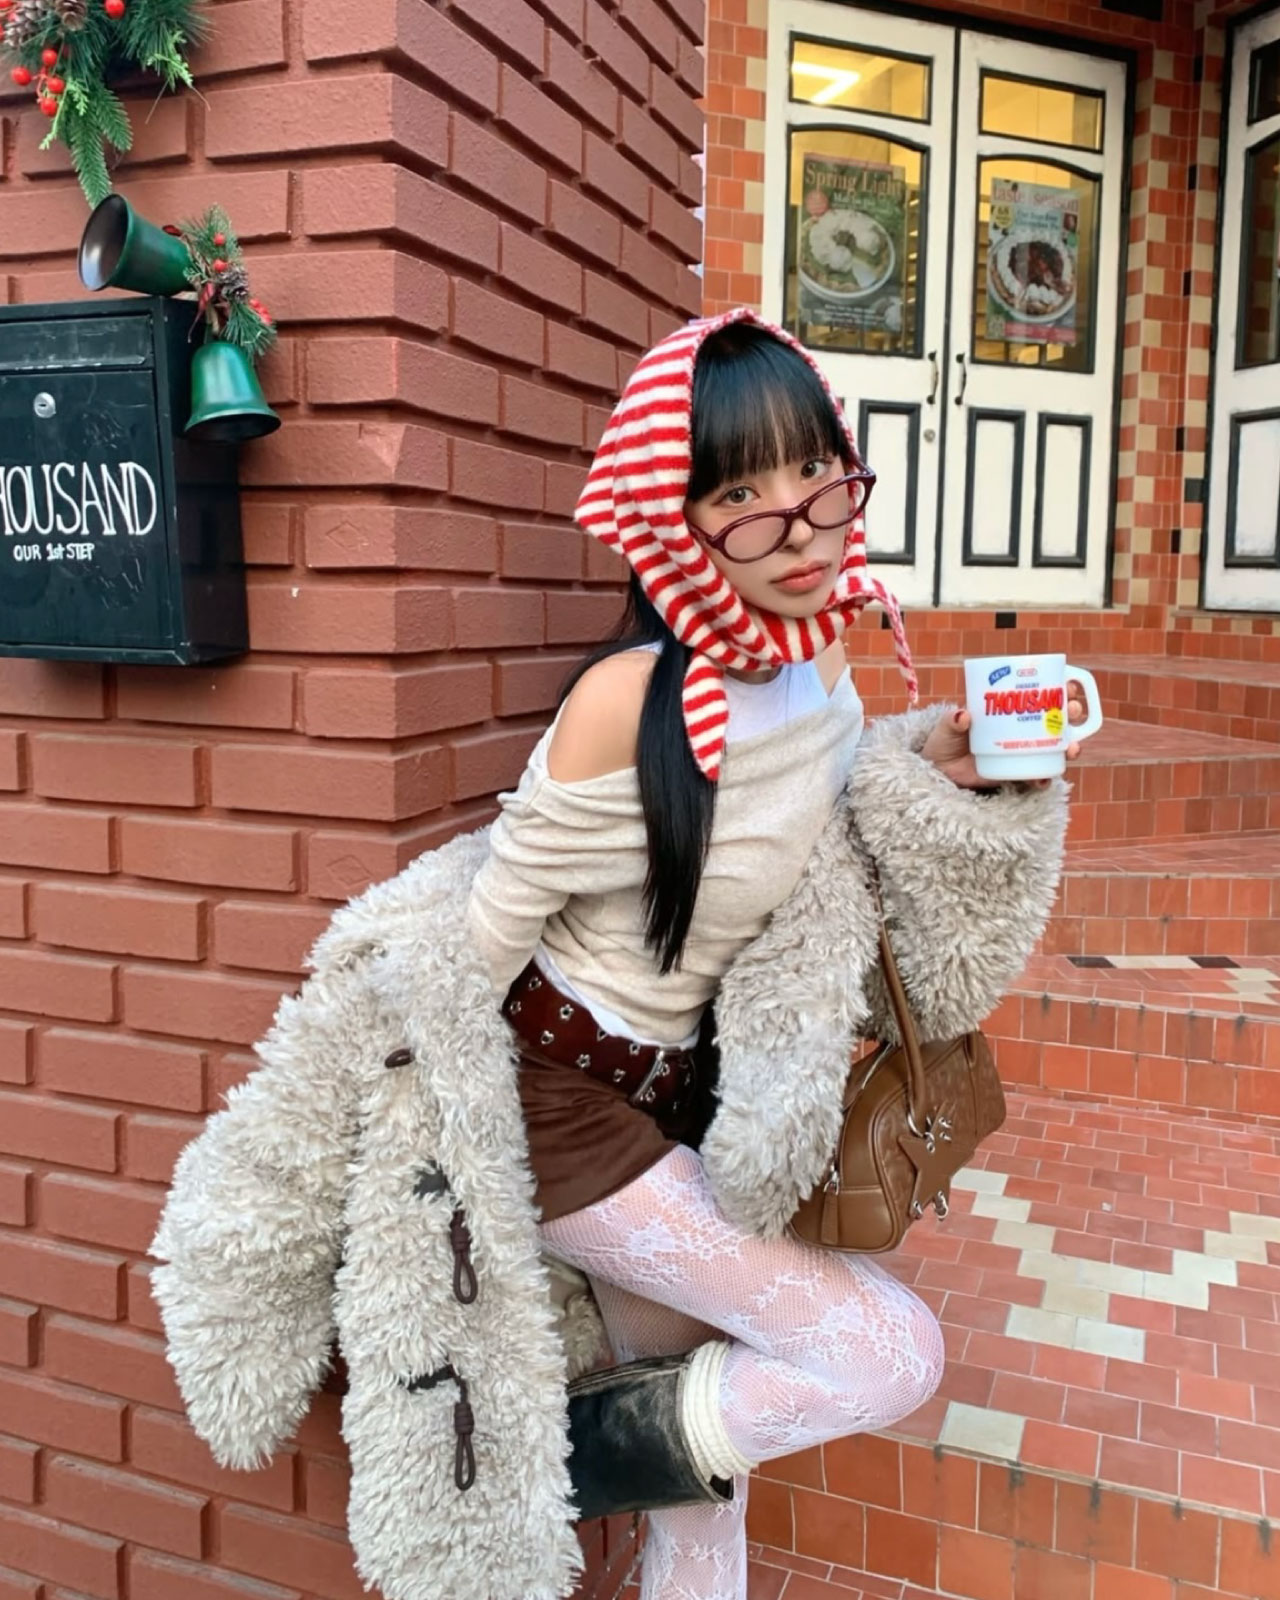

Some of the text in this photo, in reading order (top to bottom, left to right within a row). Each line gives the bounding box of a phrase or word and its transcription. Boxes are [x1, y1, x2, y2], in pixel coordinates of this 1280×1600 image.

[805, 164, 857, 196] Spring
[13, 544, 42, 561] OUR
[66, 543, 95, 560] STEP
[984, 687, 1064, 716] THOUSAND
